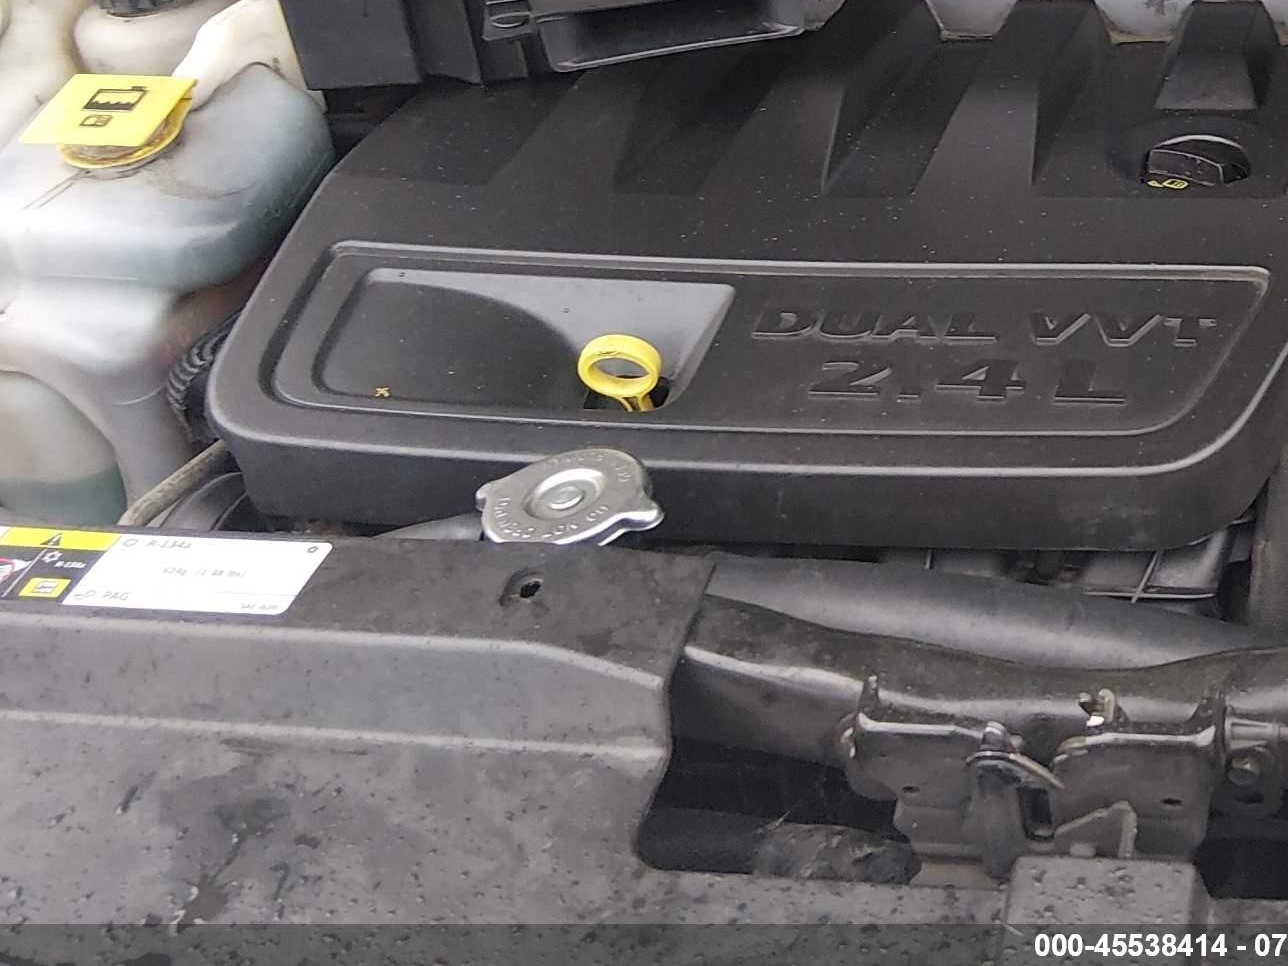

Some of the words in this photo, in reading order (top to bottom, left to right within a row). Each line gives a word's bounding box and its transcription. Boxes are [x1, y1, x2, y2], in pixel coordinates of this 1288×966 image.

[750, 306, 999, 345] DUAL
[1029, 312, 1218, 348] VVT
[808, 358, 1128, 405] 2.4L
[102, 590, 129, 602] PAG
